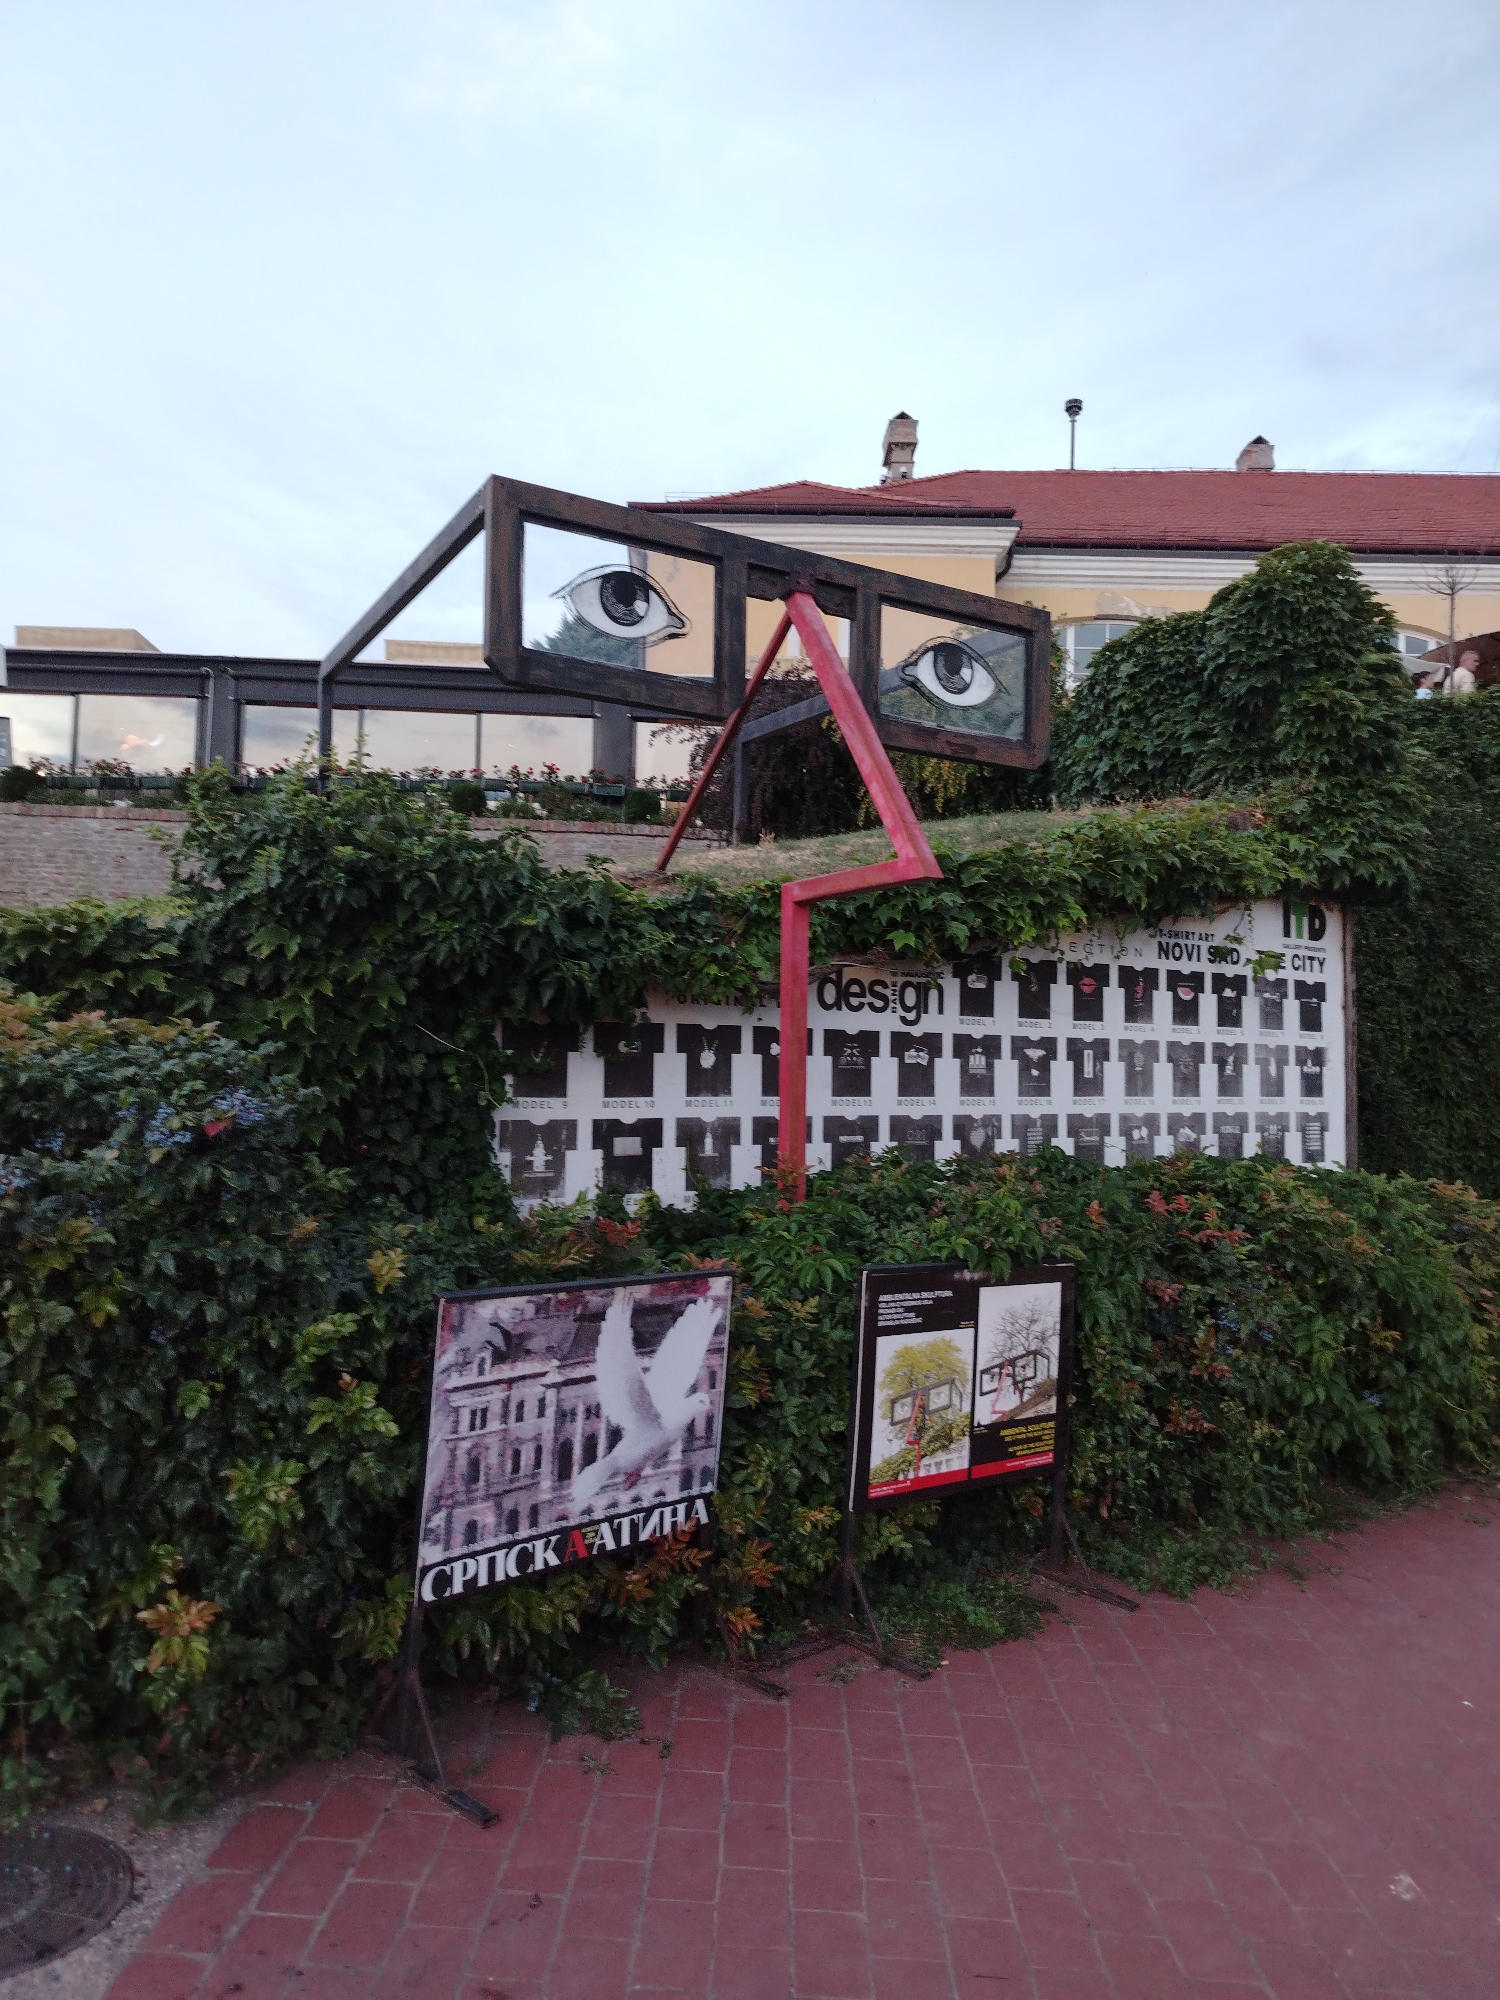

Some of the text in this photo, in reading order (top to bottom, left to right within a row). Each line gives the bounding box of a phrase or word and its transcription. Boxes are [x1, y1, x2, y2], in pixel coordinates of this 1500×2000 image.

[1198, 932, 1215, 942] ART
[1157, 941, 1201, 963] NOVI
[1291, 953, 1327, 974] CITY
[958, 1018, 987, 1026] MODEL
[1017, 1020, 1043, 1029] MODEL
[1072, 1022, 1096, 1031] MODEL
[1123, 1024, 1147, 1033] MODEL
[512, 1100, 554, 1109] MODEL
[601, 1100, 642, 1109] MODEL
[685, 1099, 720, 1108] MODEL
[831, 1098, 863, 1107] MODEL
[897, 1098, 926, 1107] MODEL
[959, 1098, 986, 1107] MODEL
